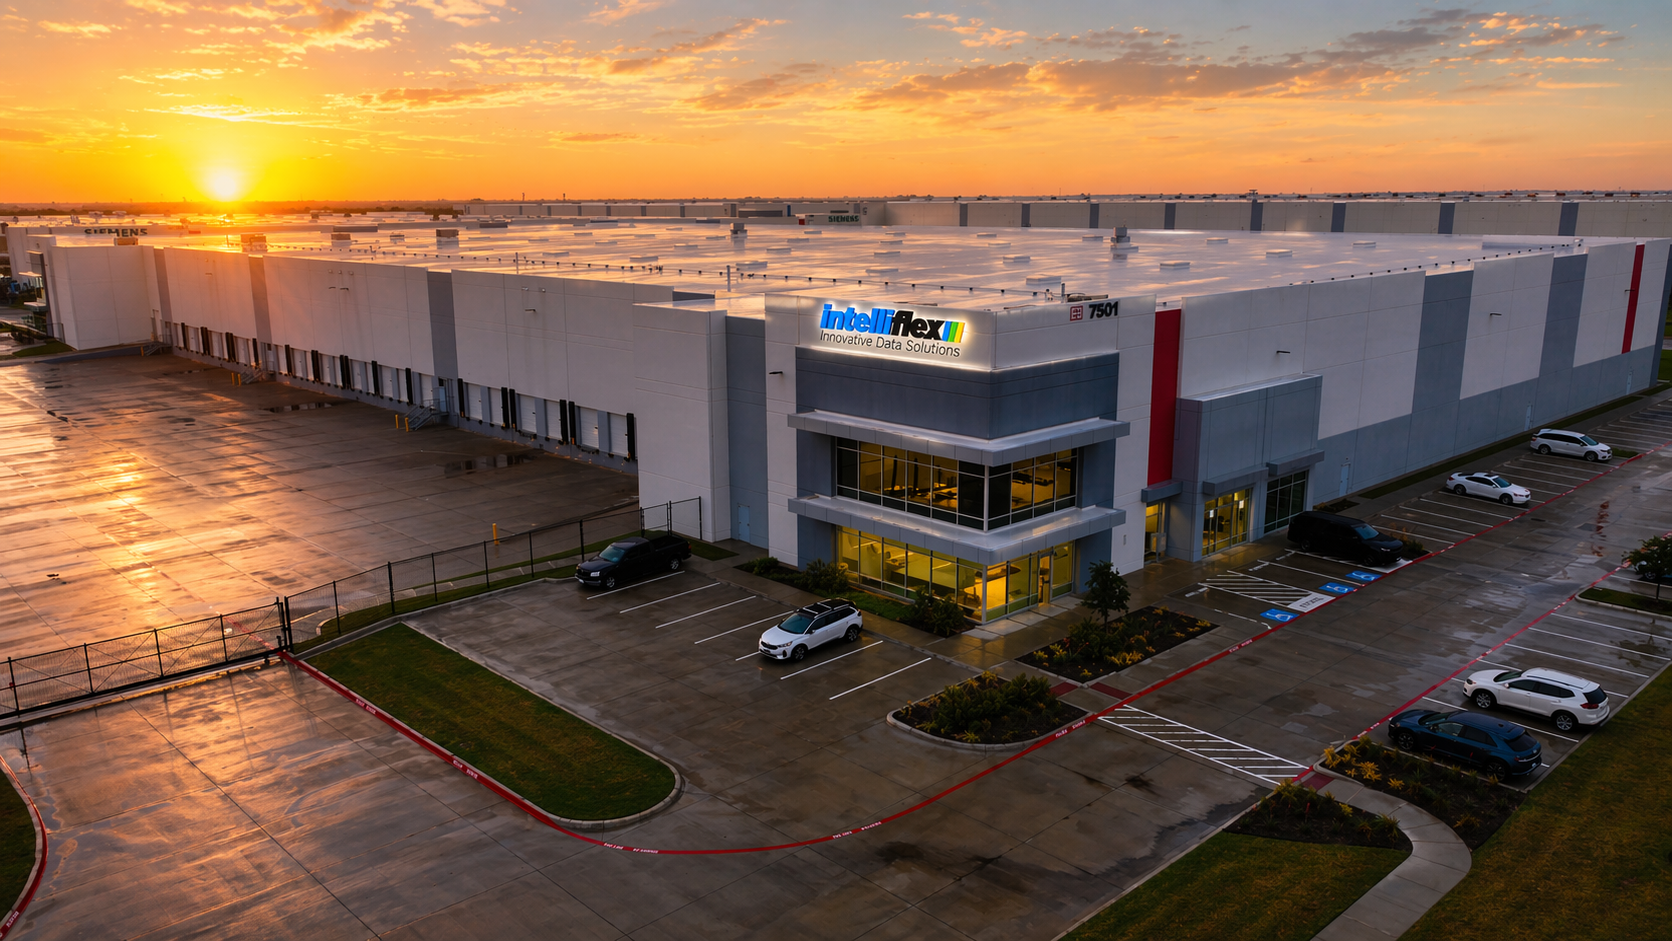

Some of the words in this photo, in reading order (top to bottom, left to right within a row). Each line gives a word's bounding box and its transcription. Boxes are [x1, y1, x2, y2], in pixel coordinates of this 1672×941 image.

[820, 303, 945, 341] intelliflex
[1088, 301, 1118, 319] 7501
[820, 330, 873, 347] Innovative
[875, 336, 902, 351] Data
[905, 339, 961, 358] Solutions
